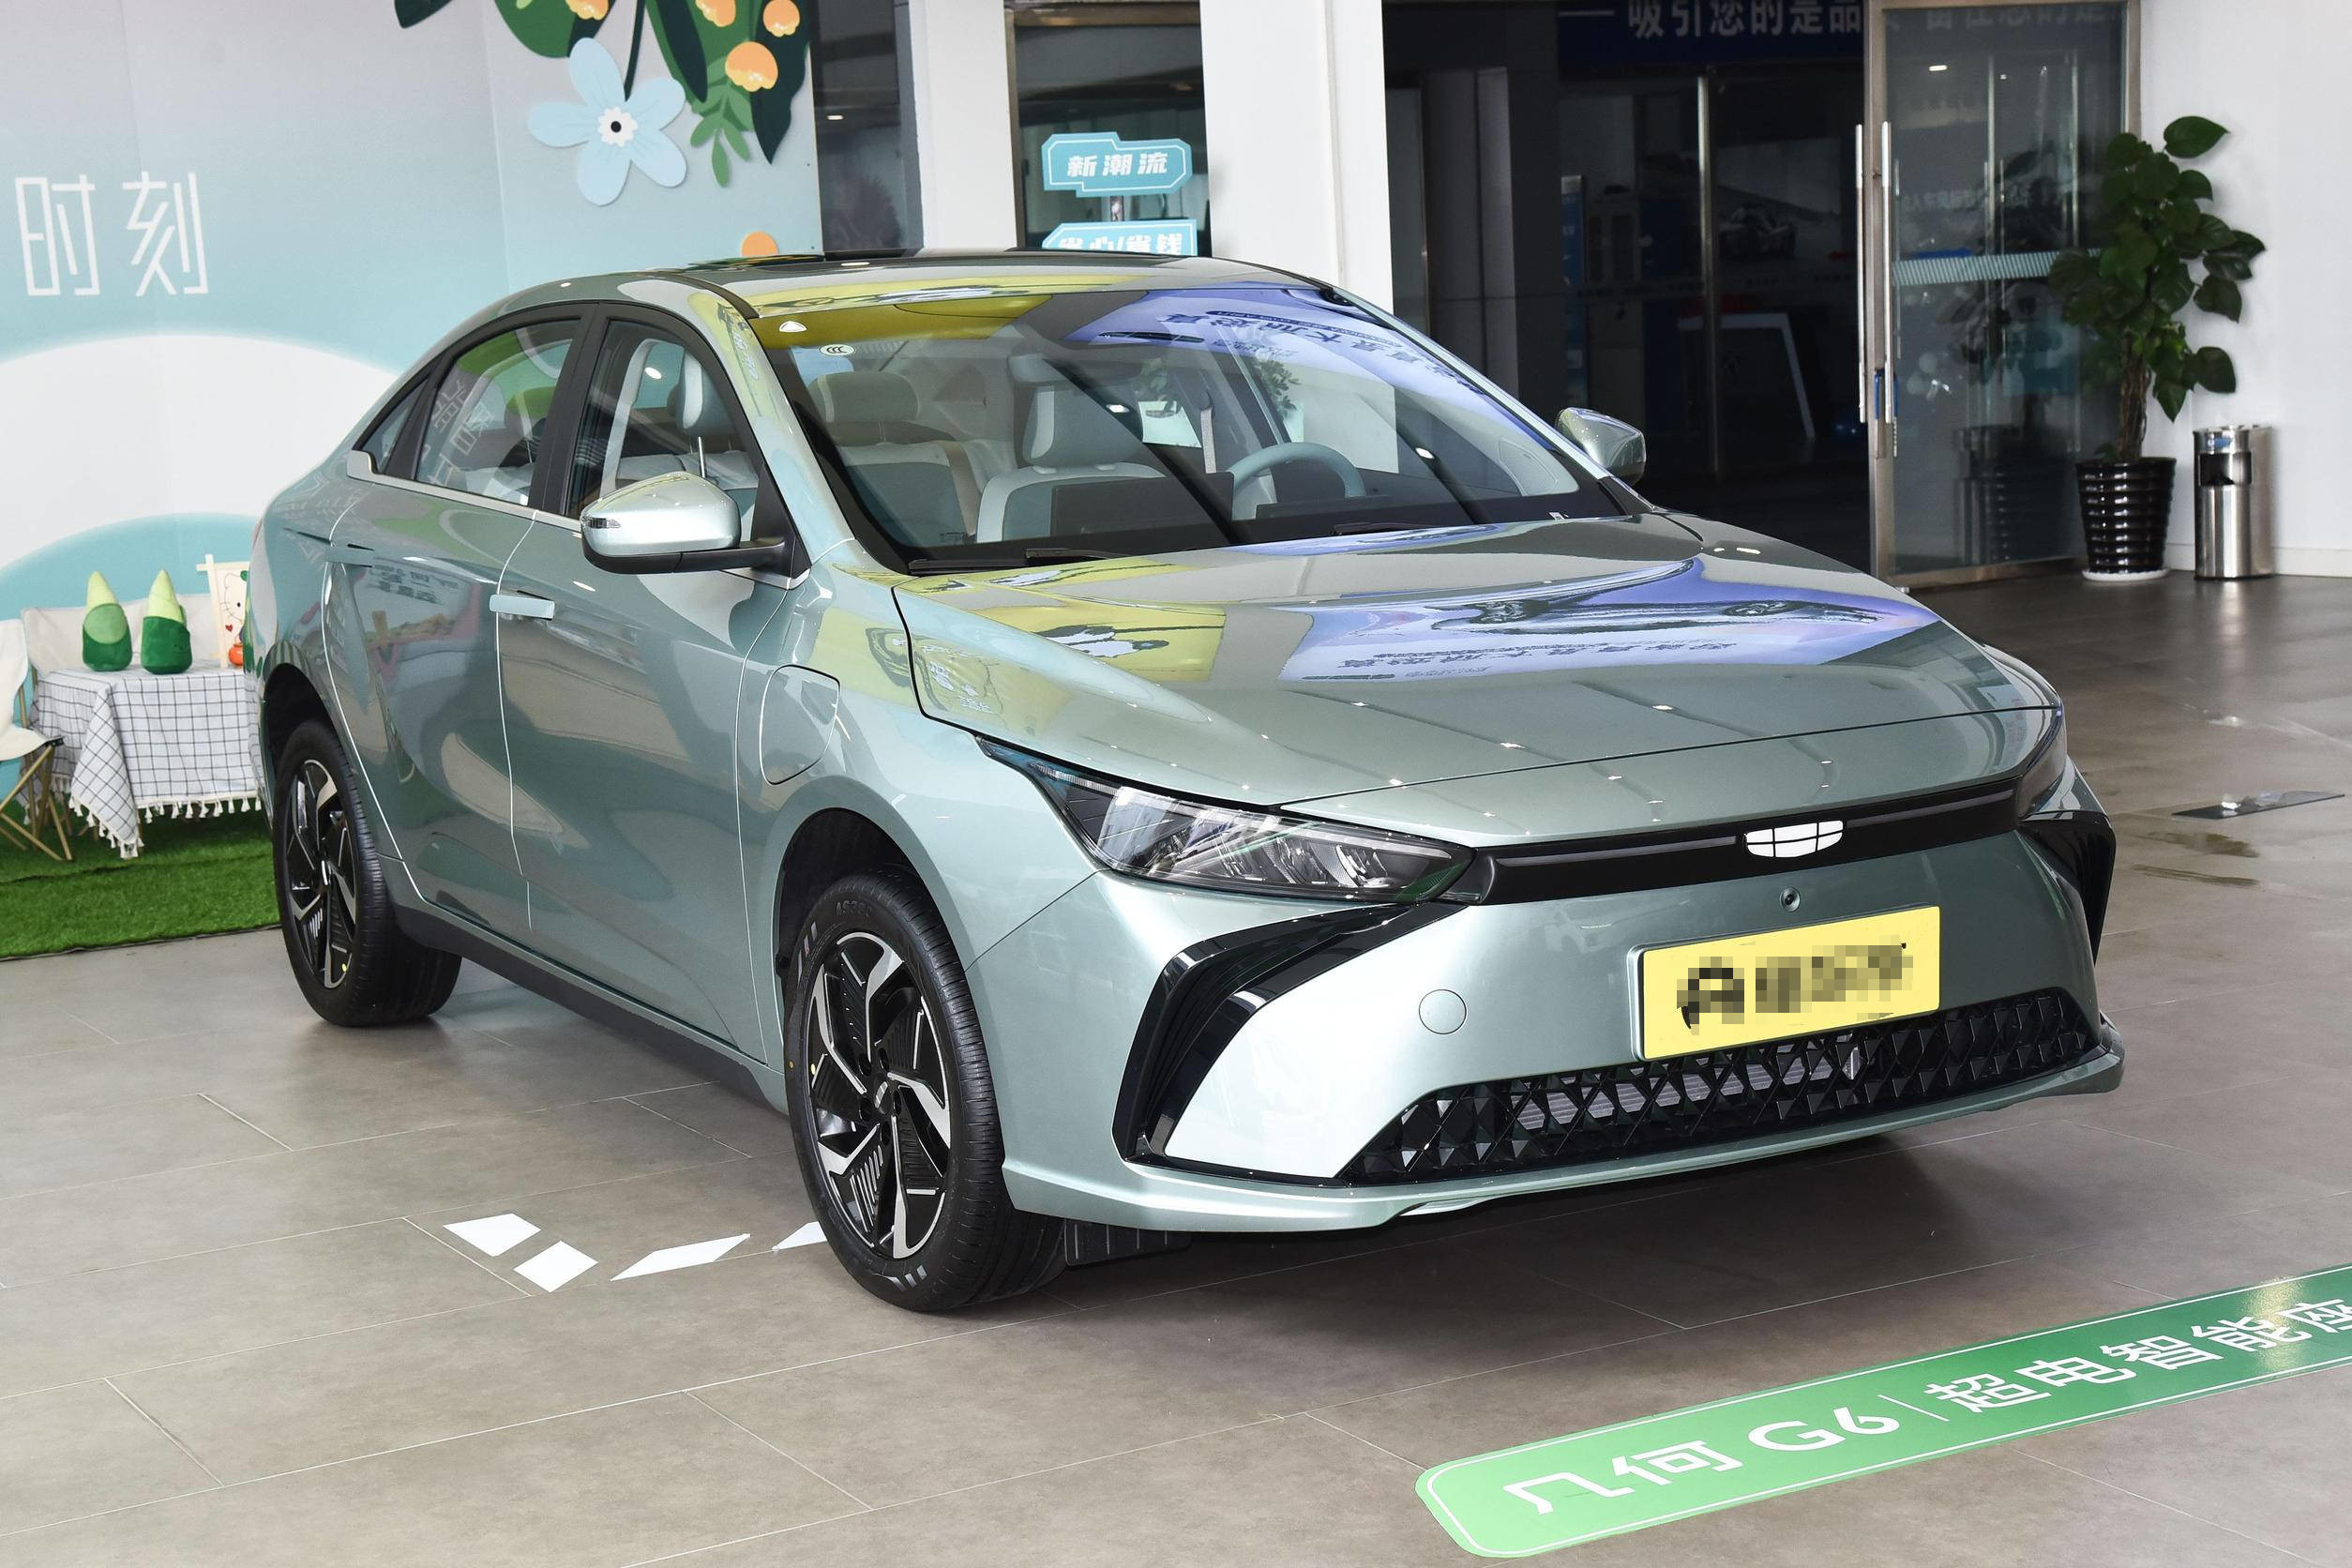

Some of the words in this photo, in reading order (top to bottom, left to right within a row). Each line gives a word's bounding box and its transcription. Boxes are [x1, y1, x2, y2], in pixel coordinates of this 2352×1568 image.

[1067, 152, 1168, 177] 新潮流
[15, 171, 209, 296] 时刻
[1502, 1440, 1743, 1515] 几何
[1748, 1407, 1900, 1452] G6
